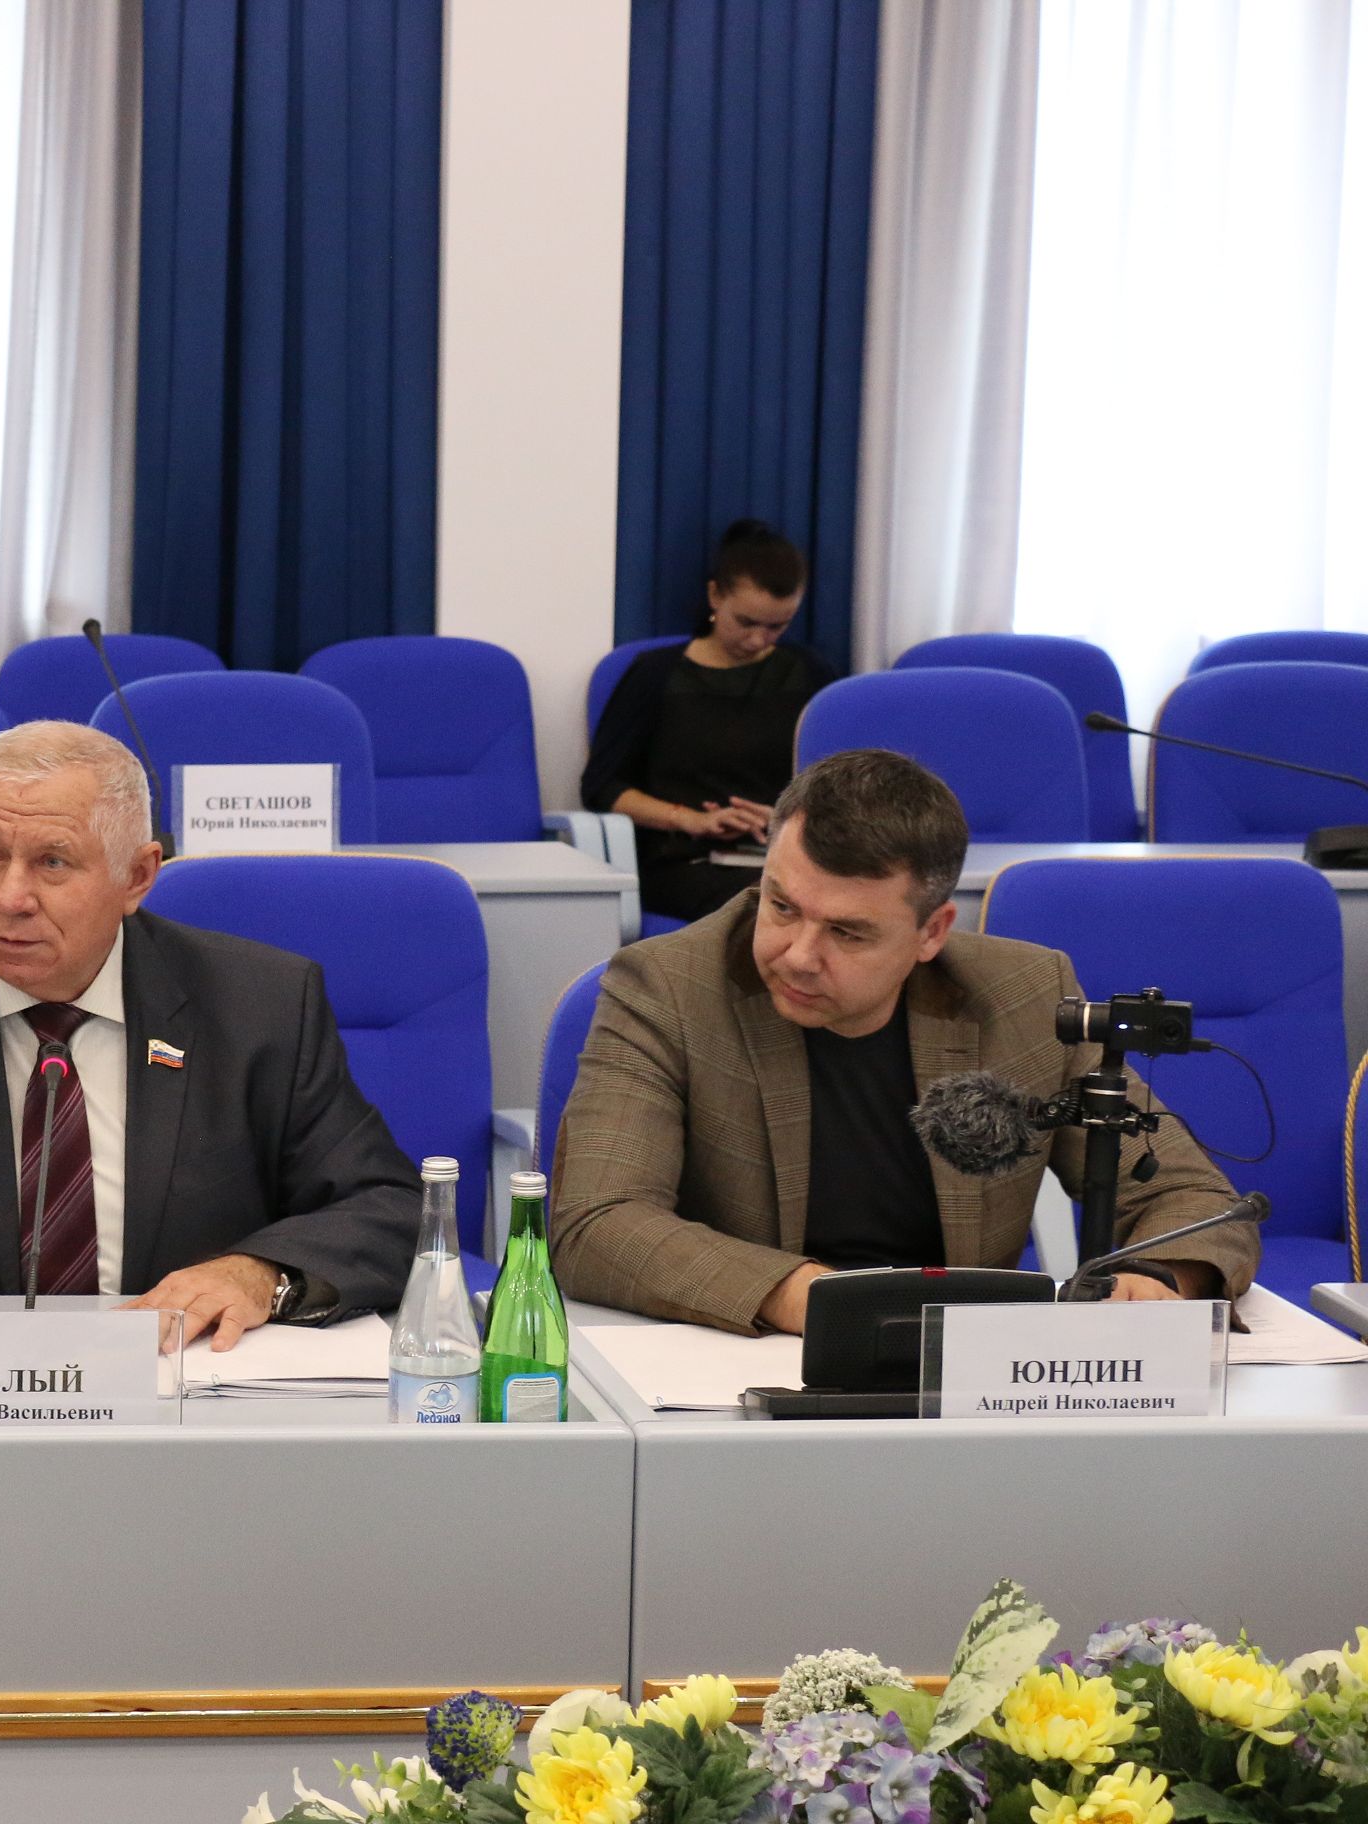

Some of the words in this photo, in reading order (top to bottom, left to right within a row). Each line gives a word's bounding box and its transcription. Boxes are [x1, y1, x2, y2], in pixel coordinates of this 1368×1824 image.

[205, 795, 313, 811] СВЕТАШОВ
[190, 816, 235, 833] Юрий
[239, 816, 328, 830] Николаевич
[1010, 1358, 1144, 1387] ЮНДИН
[975, 1394, 1048, 1415] Андрей
[1055, 1394, 1176, 1411] Николаевич
[416, 1411, 461, 1423] Ледяная
